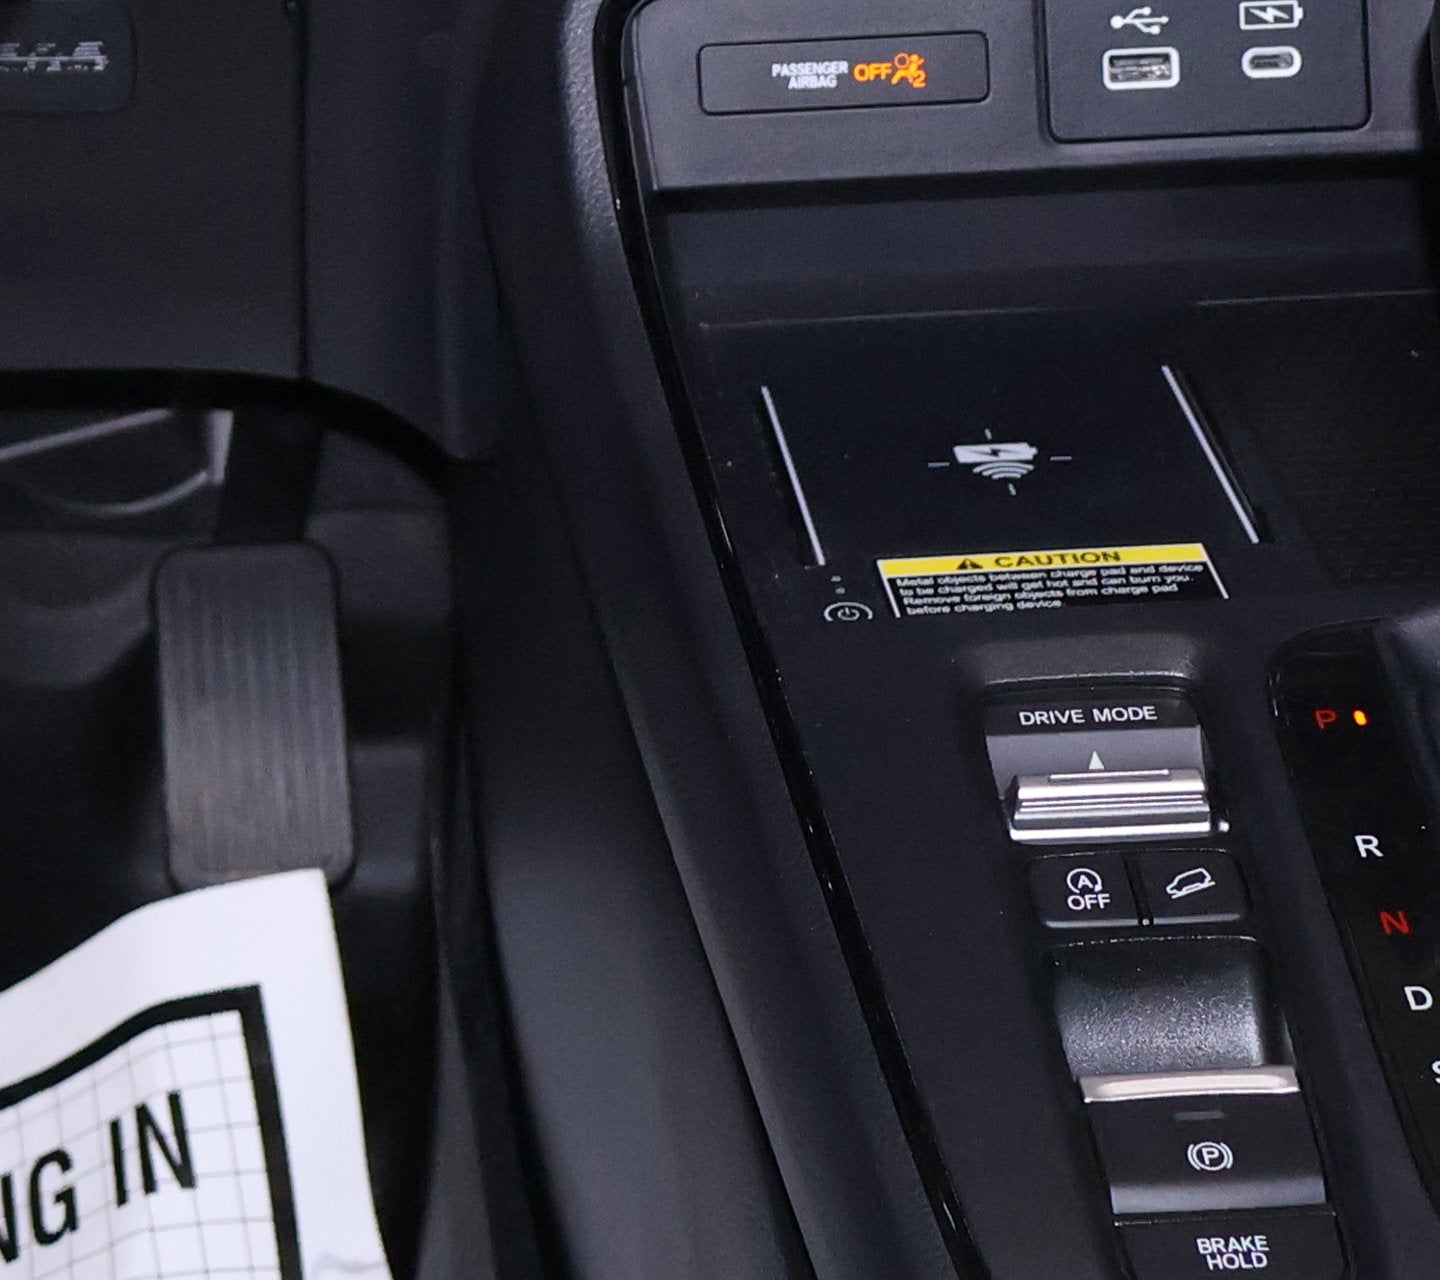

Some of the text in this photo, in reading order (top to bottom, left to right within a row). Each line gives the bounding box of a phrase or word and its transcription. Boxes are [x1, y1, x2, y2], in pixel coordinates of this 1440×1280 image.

[771, 60, 849, 78] PASSENGER
[853, 62, 893, 82] OFF
[787, 74, 839, 90] AIRBAG
[994, 551, 1121, 568] CAUTION
[989, 571, 1048, 582] between
[1100, 567, 1127, 577] pad
[1130, 565, 1156, 574] and
[1158, 563, 1205, 573] device
[903, 583, 1179, 606] Remove foreign objects from charge pad
[937, 583, 993, 595] charged
[1072, 577, 1098, 587] and
[1101, 576, 1127, 585] can
[1129, 574, 1161, 584] burn
[906, 604, 952, 615] before
[953, 602, 1014, 613] charging
[1018, 705, 1159, 726] DRIVE MODE
[1315, 709, 1338, 731] P
[1354, 834, 1384, 858] R
[1066, 893, 1111, 911] OFF
[1380, 911, 1411, 935] N
[1403, 985, 1434, 1012] D
[108, 1089, 197, 1207] IN
[1196, 1235, 1270, 1255] BRAKE
[1205, 1251, 1269, 1271] HOLD
